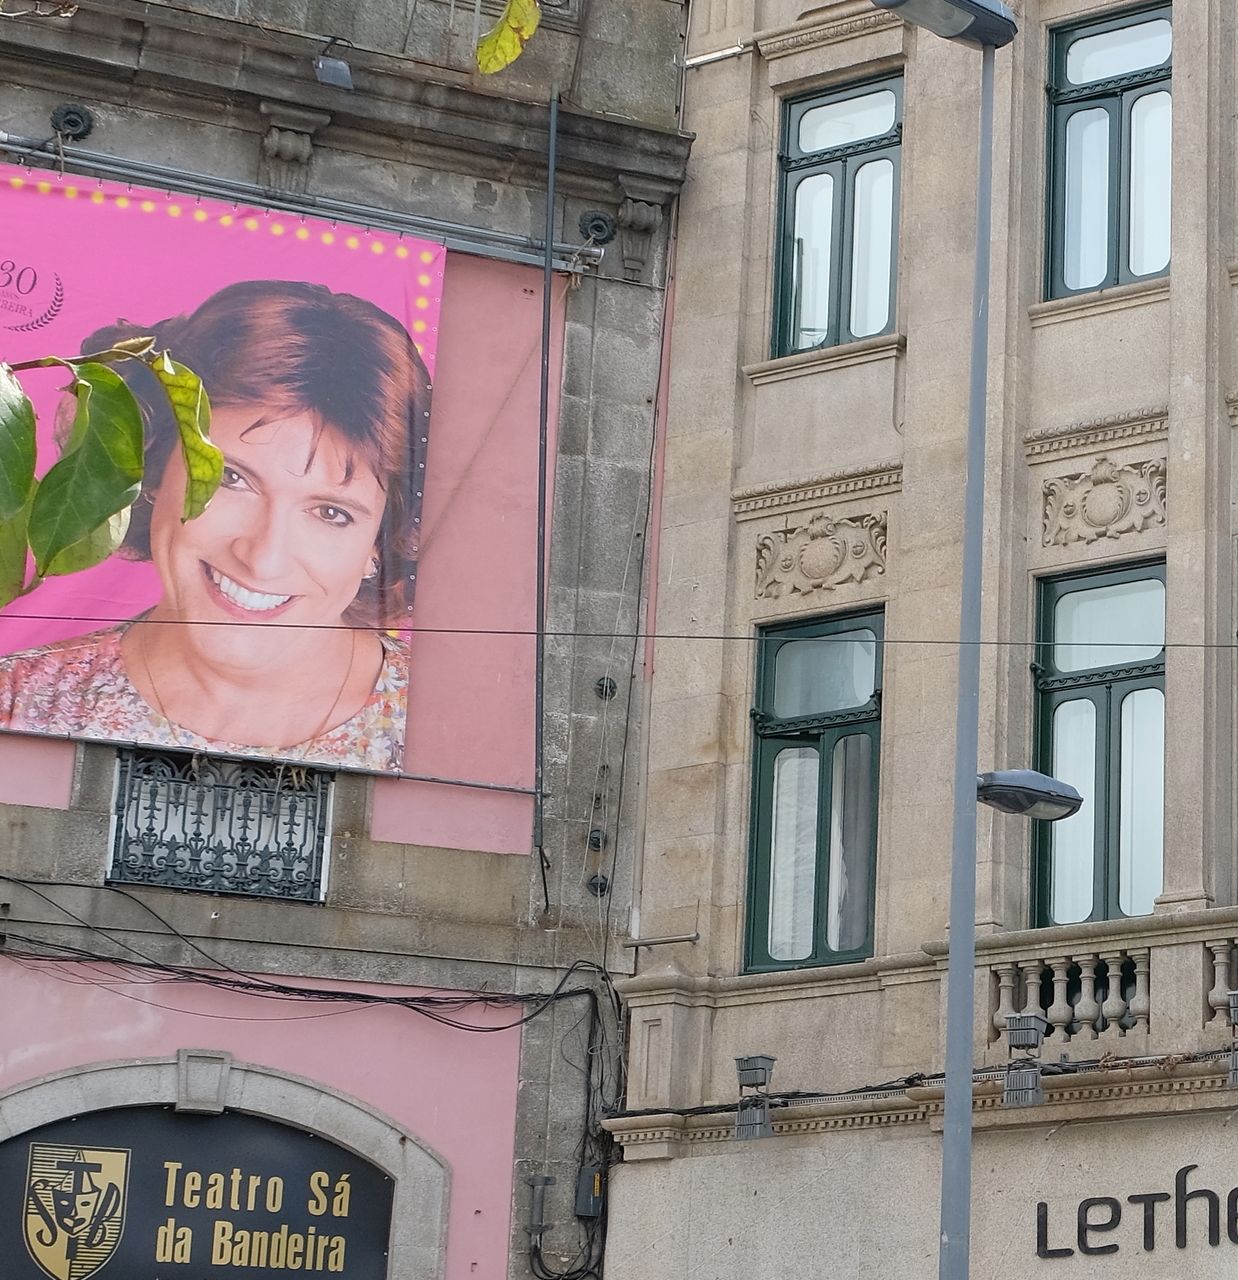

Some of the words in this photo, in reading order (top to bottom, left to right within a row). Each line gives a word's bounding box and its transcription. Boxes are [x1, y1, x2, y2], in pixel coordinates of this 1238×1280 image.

[163, 1161, 284, 1213] Teatro
[307, 1171, 350, 1217] Sá
[155, 1218, 193, 1264] da
[211, 1220, 346, 1272] Bandeira
